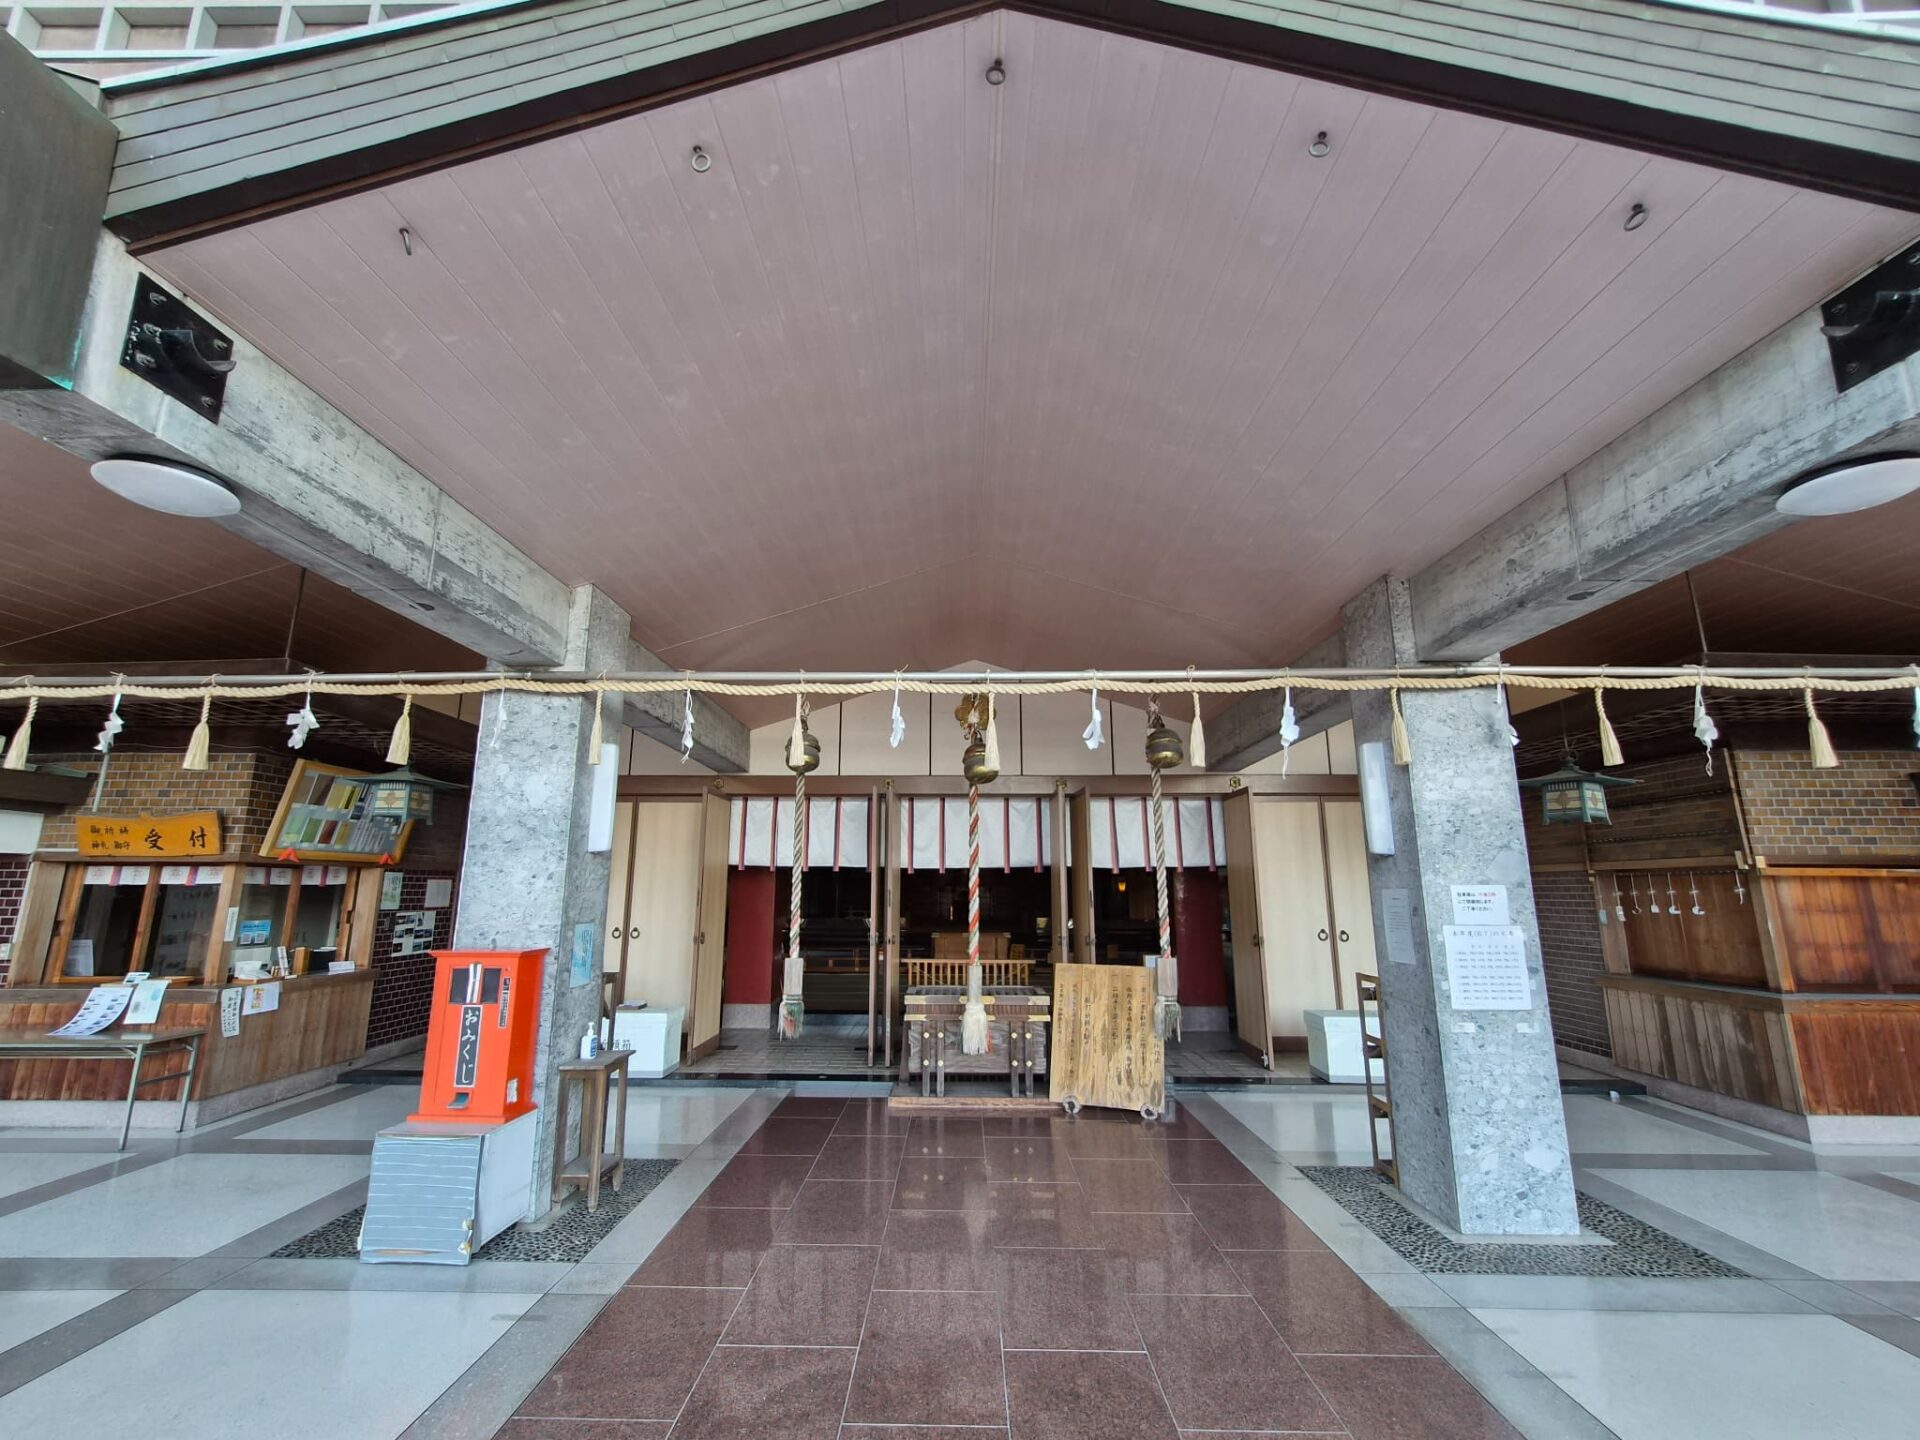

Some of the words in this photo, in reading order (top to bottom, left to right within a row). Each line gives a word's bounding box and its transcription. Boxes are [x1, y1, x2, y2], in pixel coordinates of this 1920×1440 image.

[144, 826, 207, 851] 受付
[461, 1009, 479, 1084] おみくじ
